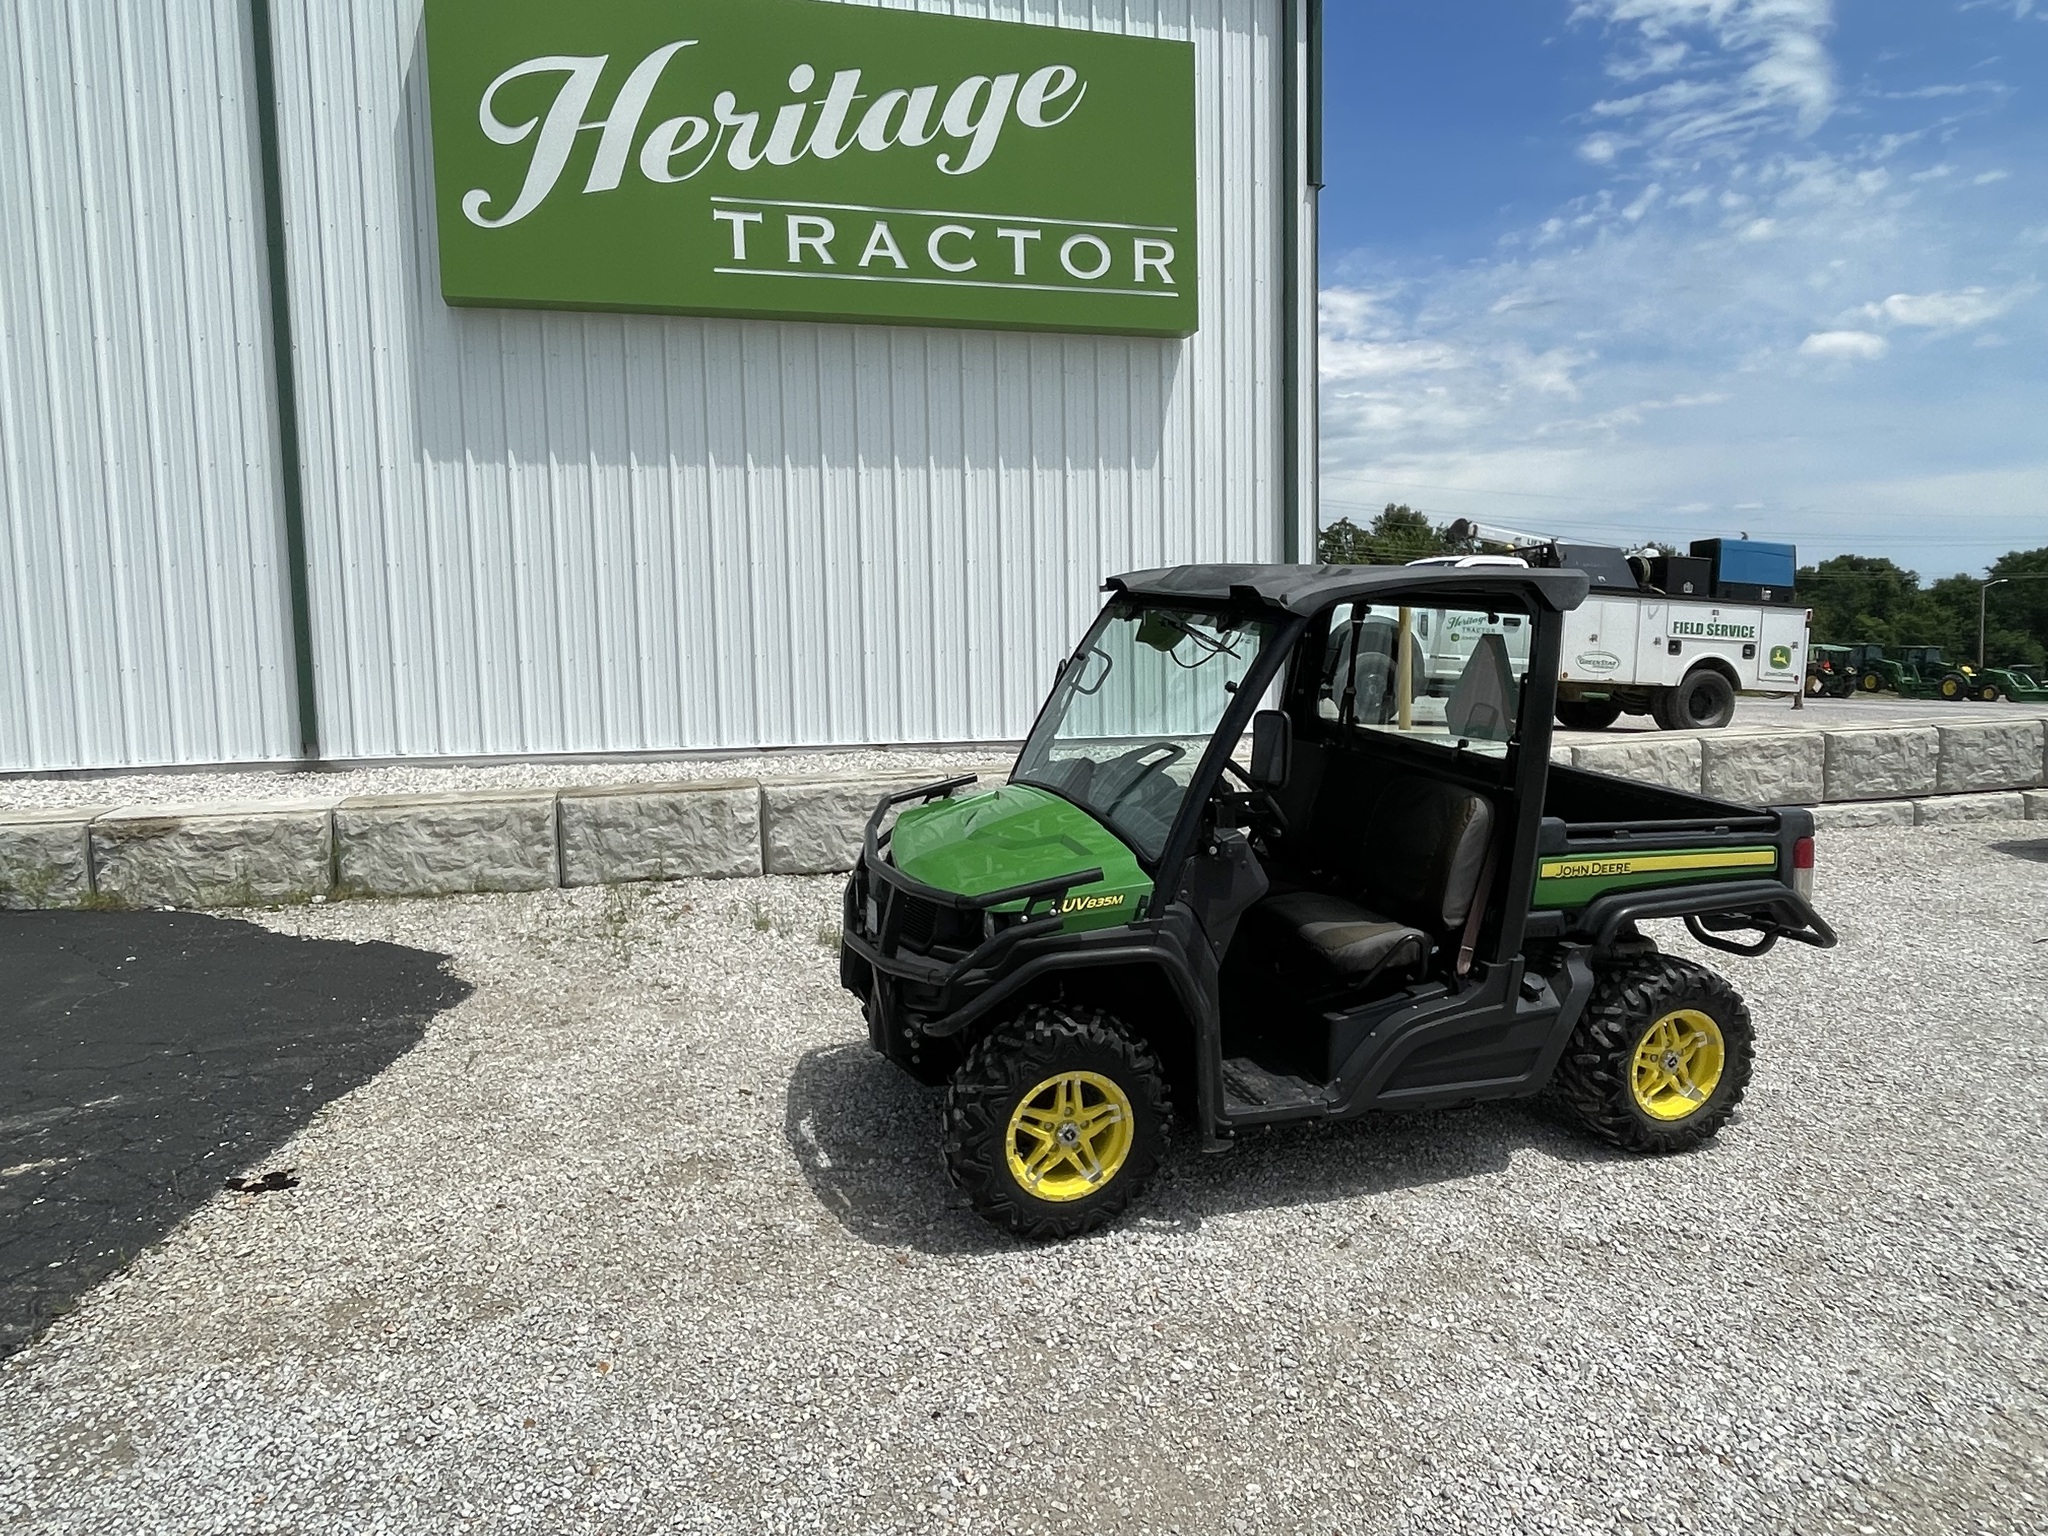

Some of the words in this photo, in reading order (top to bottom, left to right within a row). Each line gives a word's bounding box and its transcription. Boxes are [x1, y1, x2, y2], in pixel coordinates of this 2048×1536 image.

[461, 40, 1087, 229] Heritage
[713, 208, 1176, 284] TRACTOR
[1673, 621, 1704, 635] FIELD
[1706, 623, 1755, 638] SERVICE
[1556, 864, 1590, 877] JOHN
[1591, 862, 1632, 874] DEERE
